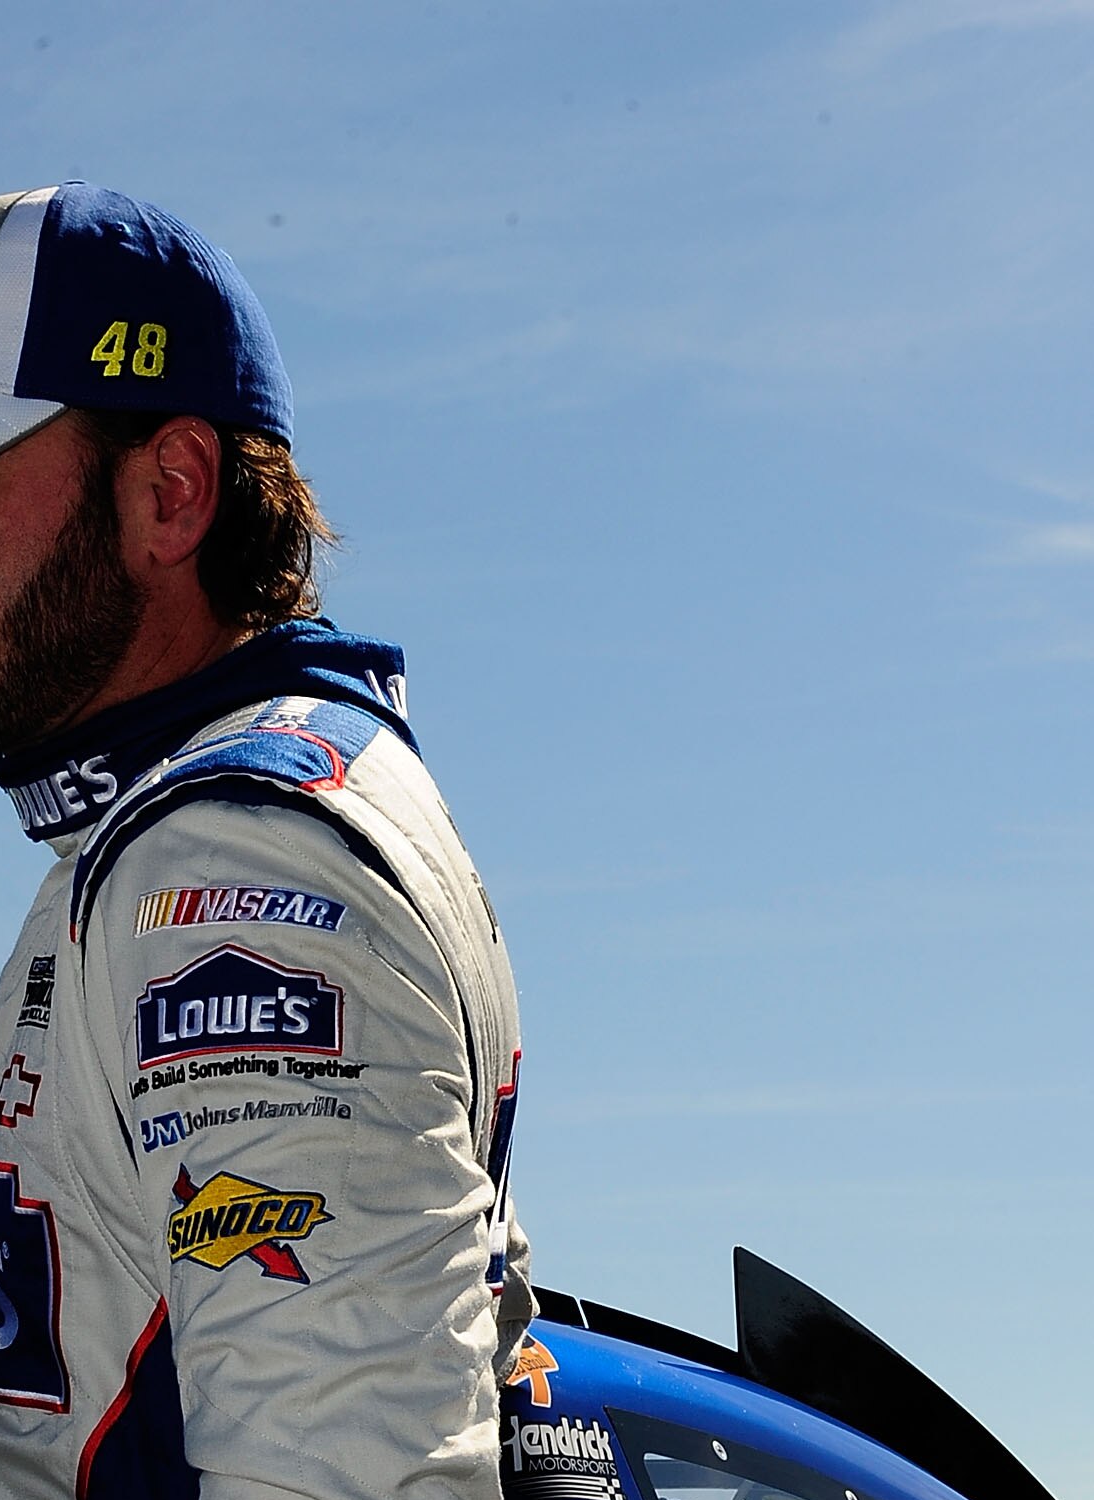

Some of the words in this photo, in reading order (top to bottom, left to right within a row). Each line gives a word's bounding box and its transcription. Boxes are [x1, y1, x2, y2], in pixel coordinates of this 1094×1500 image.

[91, 321, 166, 377] 48
[8, 755, 117, 831] OWE'S
[192, 889, 330, 926] NASCAR
[157, 987, 310, 1043] LOWE'S
[152, 1064, 186, 1090] Build
[189, 1054, 280, 1080] Something
[283, 1056, 364, 1080] Together
[185, 1106, 241, 1137] Johns
[243, 1095, 352, 1121] Manville
[170, 1199, 314, 1254] SUNOCO
[528, 1457, 617, 1476] MOTORSPORTS
